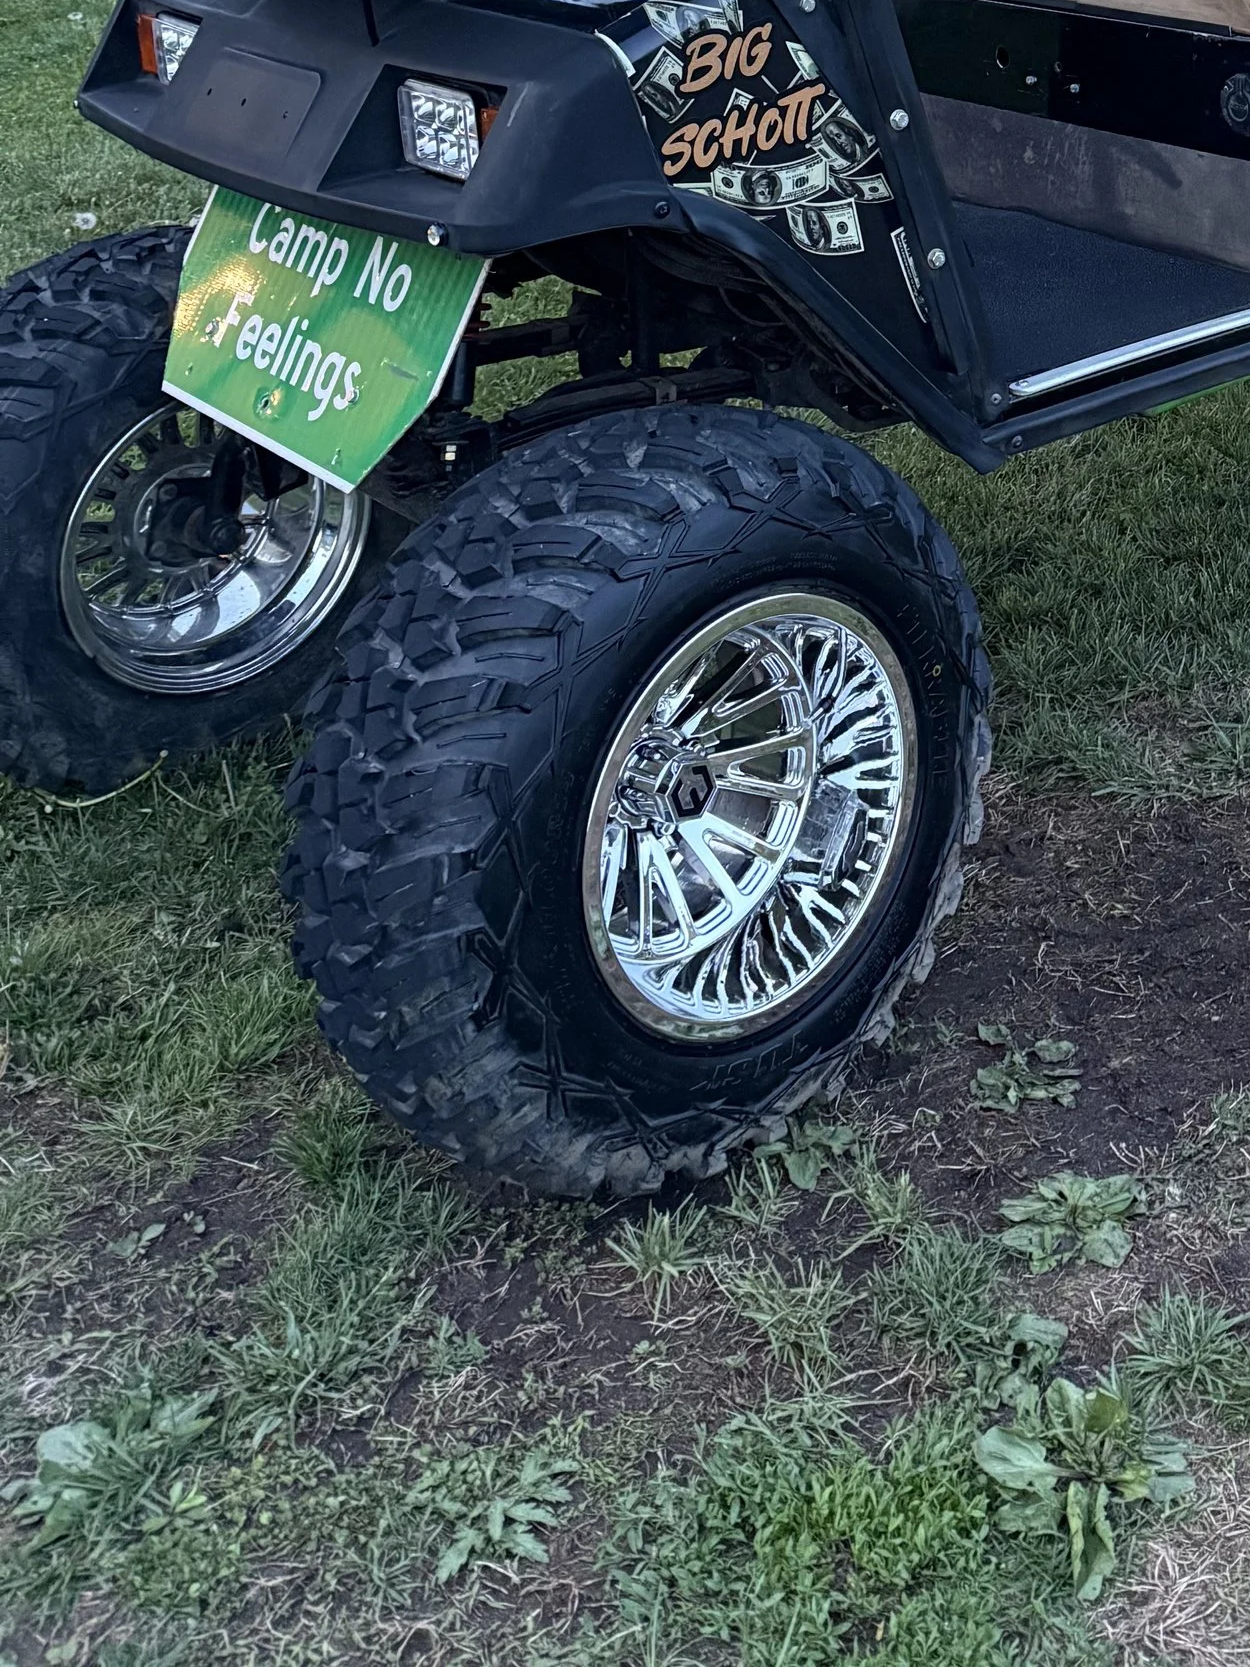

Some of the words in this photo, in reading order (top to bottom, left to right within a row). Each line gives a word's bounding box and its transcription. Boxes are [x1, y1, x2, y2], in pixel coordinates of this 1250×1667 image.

[679, 22, 772, 93] BIG
[660, 84, 826, 176] SCHOTT
[249, 201, 349, 298] Camp
[353, 236, 413, 312] No
[211, 292, 362, 421] Feelings
